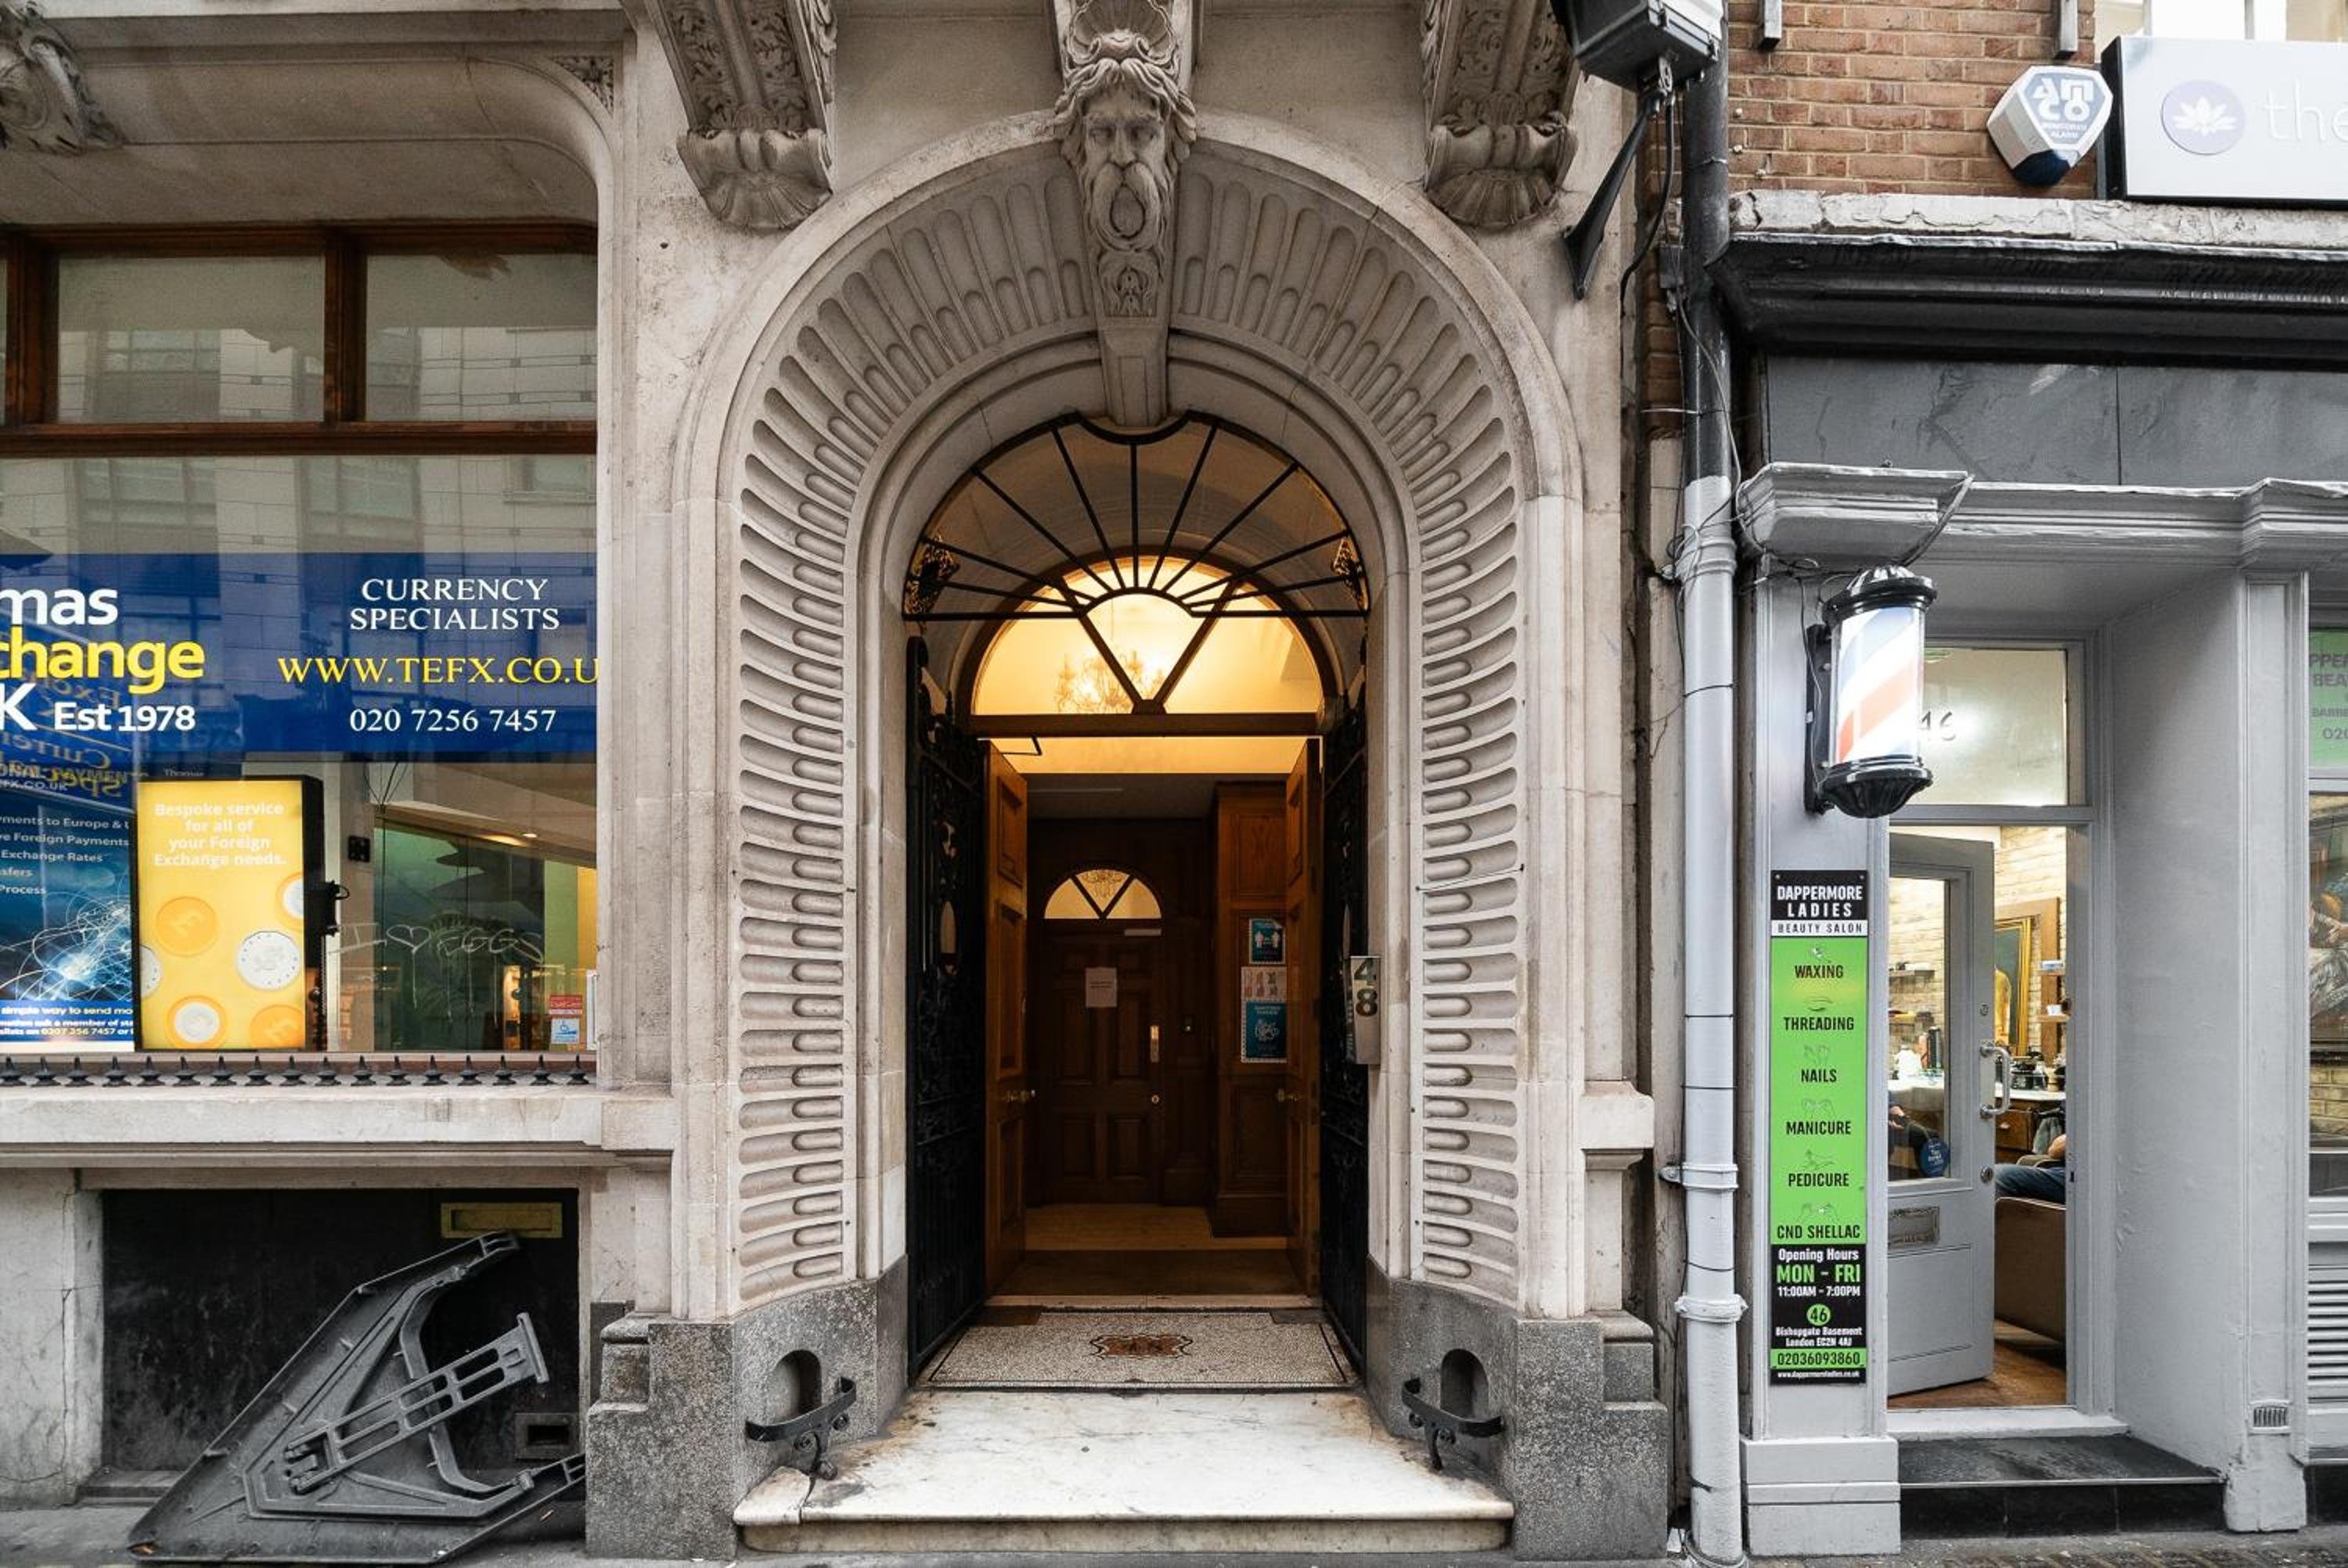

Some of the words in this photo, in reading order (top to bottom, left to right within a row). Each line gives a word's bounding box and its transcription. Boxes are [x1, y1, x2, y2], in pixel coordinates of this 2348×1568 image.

[362, 578, 549, 602] CURRENCY
[0, 588, 118, 625] mas
[350, 608, 560, 631] SPECIALISTS
[54, 701, 112, 731] Est
[118, 705, 196, 732] 1978
[349, 708, 402, 732] 020
[411, 708, 479, 732] 7256
[488, 708, 557, 732] 7457
[154, 804, 223, 818] Bespoke
[226, 804, 284, 815] service
[47, 817, 60, 825] to
[63, 818, 110, 829] Europe
[185, 820, 209, 832] for
[214, 820, 232, 832] all
[238, 820, 254, 832] of
[14, 833, 63, 845] Foreign
[67, 835, 129, 847] Payments
[168, 838, 207, 851] your
[210, 836, 271, 851] Foreign
[2, 849, 64, 863] Exchange
[67, 852, 103, 862] Rates
[154, 853, 229, 869] Exchange
[1777, 885, 1863, 901] DAPPERMORE
[1787, 902, 1853, 918] LADIES
[1777, 923, 1820, 933] BEAUTY
[1826, 923, 1863, 933] SALON
[1794, 965, 1844, 979] WAXING
[70, 1006, 81, 1015] to
[84, 1006, 111, 1015] send
[1783, 1016, 1855, 1030] THREADING
[1801, 1069, 1838, 1083] NAILS
[1785, 1120, 1852, 1135] MANICURE
[1788, 1173, 1849, 1187] PEDICURE
[1777, 1225, 1802, 1239] CND
[1807, 1224, 1861, 1239] SHELLAC
[1778, 1247, 1824, 1263] Opening
[1826, 1247, 1860, 1261] Hours
[1776, 1264, 1815, 1282] MON
[1835, 1264, 1861, 1282] FRI
[1777, 1286, 1817, 1296] 11:00AM
[1826, 1286, 1861, 1296] 7:00PM
[1809, 1307, 1828, 1323] 46
[1785, 1337, 1815, 1347] London
[1777, 1351, 1860, 1365] 02036093860
